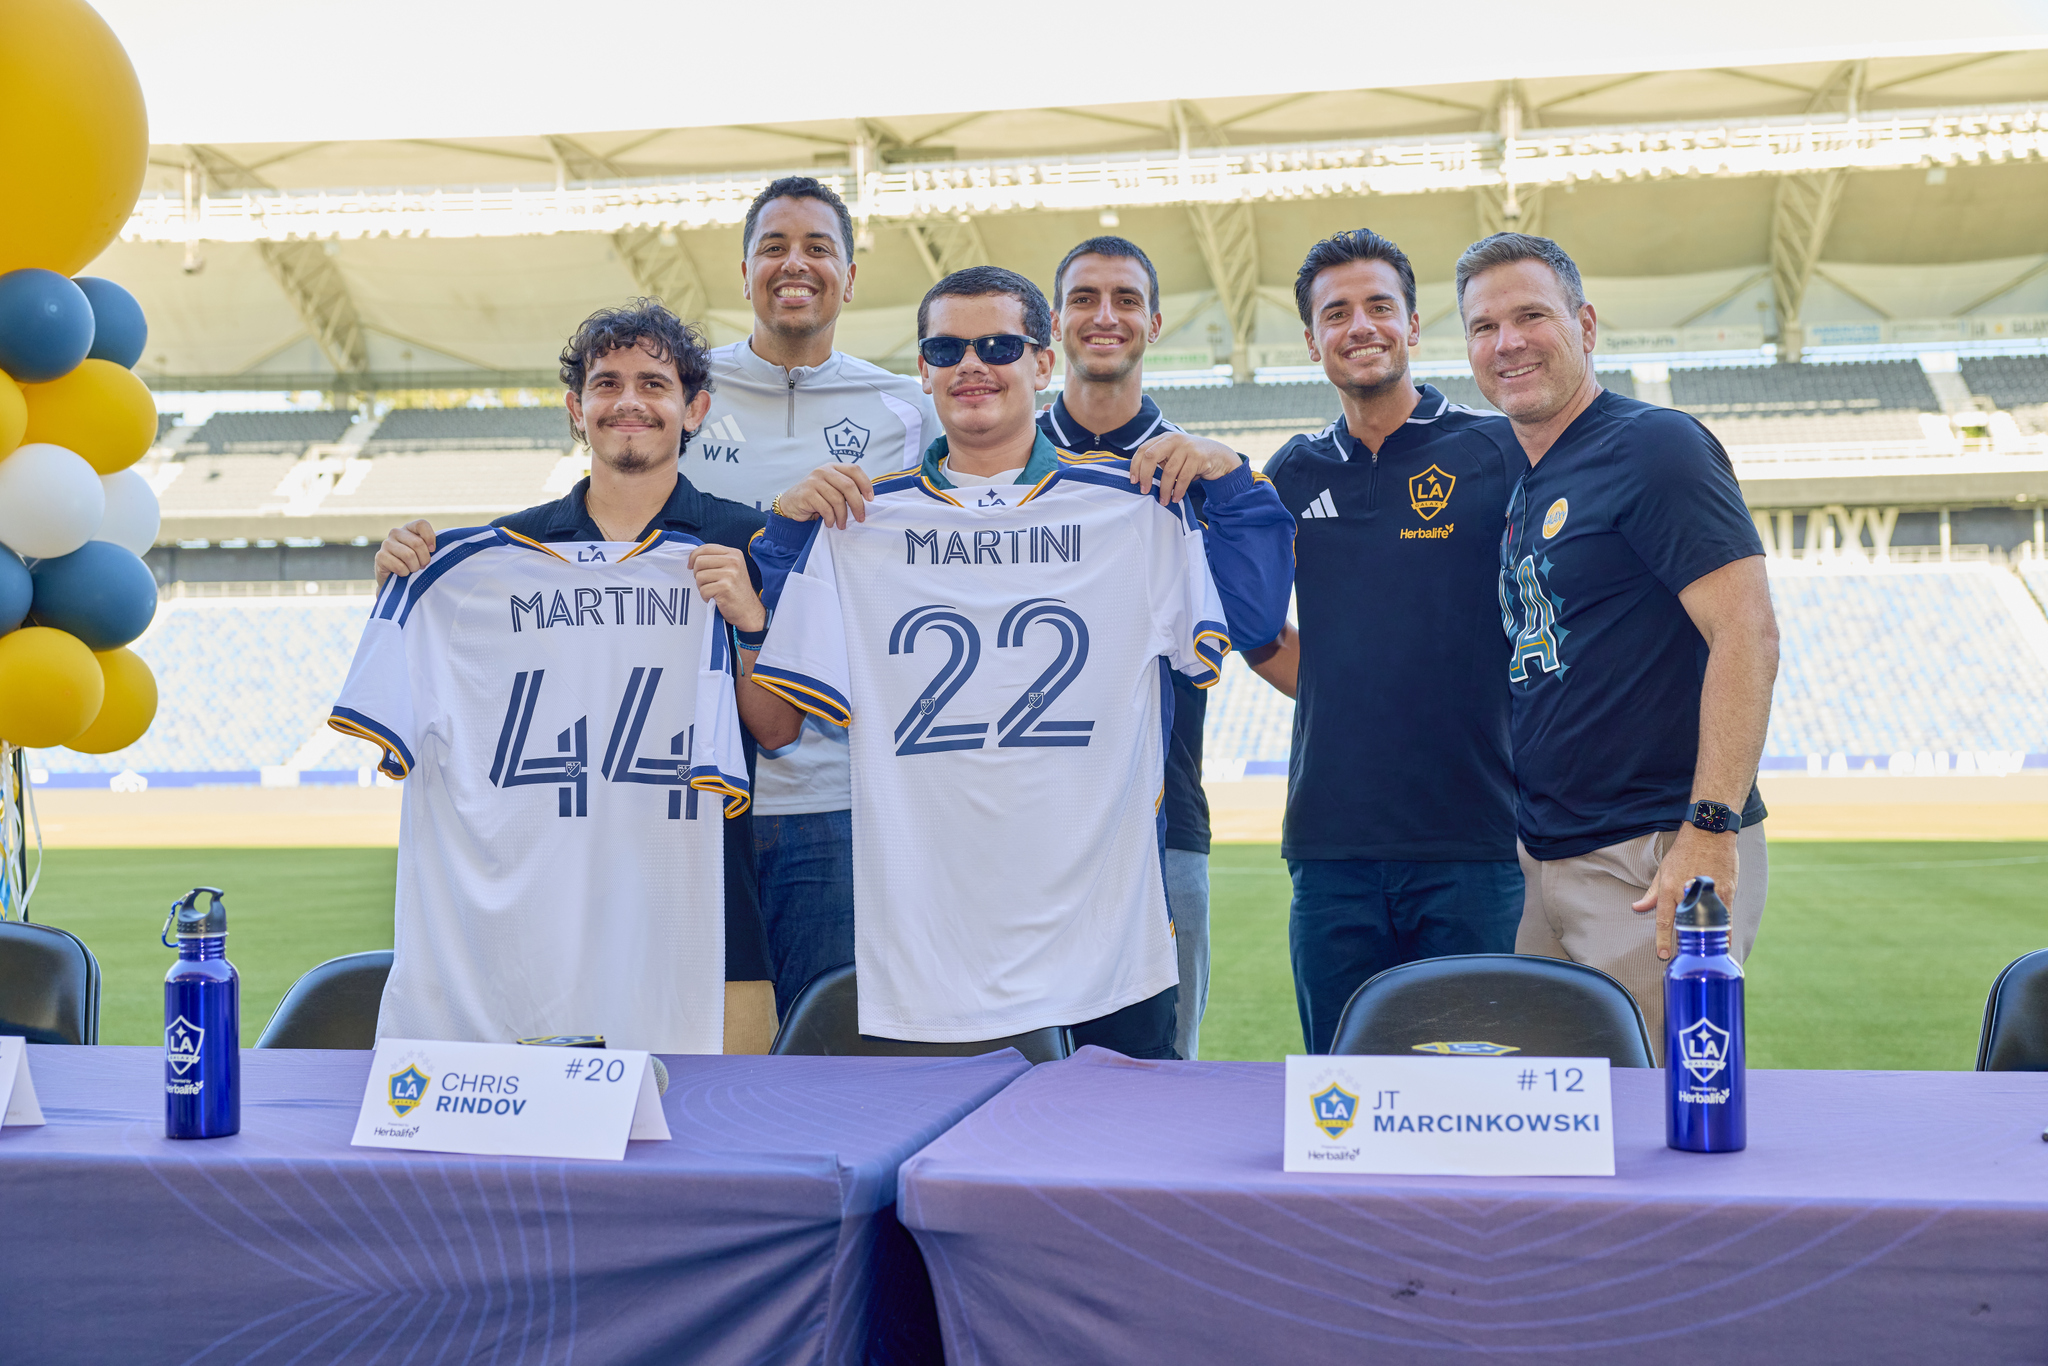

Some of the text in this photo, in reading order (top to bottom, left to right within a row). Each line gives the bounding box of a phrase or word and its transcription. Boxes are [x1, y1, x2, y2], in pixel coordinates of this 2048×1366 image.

[834, 434, 861, 448] LA
[1417, 483, 1444, 499] LA
[977, 498, 1006, 508] LA
[1399, 526, 1450, 540] Herbalife
[903, 523, 1082, 565] MARTINI
[577, 550, 607, 563] LA
[510, 586, 691, 633] MARTINI
[888, 597, 1096, 757] 22
[488, 667, 698, 820] 44
[170, 1035, 195, 1053] LA
[1688, 1038, 1721, 1059] LA
[564, 1057, 625, 1083] #20
[441, 1072, 520, 1095] CHRIS
[1516, 1067, 1585, 1092] #12
[394, 1081, 419, 1099] LA
[1678, 1090, 1727, 1105] Herbalife
[435, 1095, 527, 1116] RINDOV
[1372, 1090, 1401, 1111] JT
[1320, 1101, 1350, 1119] LA
[373, 1126, 415, 1139] Herbalife
[1373, 1114, 1600, 1133] MARCINKOWSKI
[1307, 1150, 1356, 1161] Herbalife
